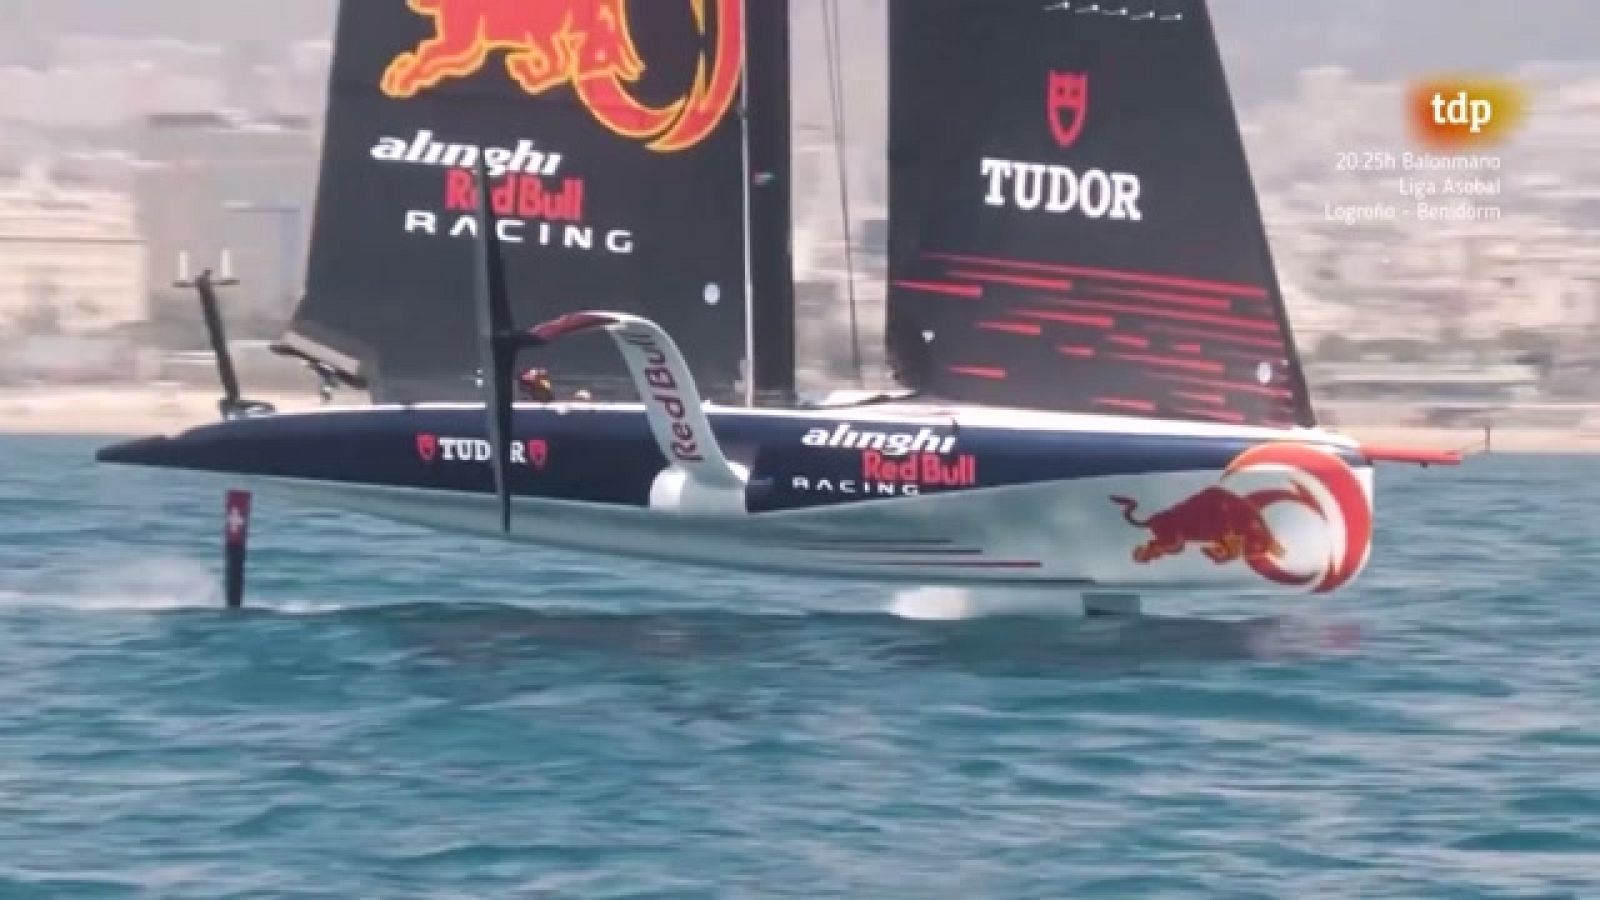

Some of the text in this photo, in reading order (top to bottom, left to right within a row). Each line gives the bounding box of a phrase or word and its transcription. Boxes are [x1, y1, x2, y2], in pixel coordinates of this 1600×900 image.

[369, 129, 563, 175] alinghi
[444, 167, 517, 214] Rd
[980, 157, 1142, 221] TUDOR
[404, 210, 633, 254] RACING
[439, 438, 526, 463] TUDR
[801, 423, 956, 455] alinghi
[792, 475, 920, 495] RACING
